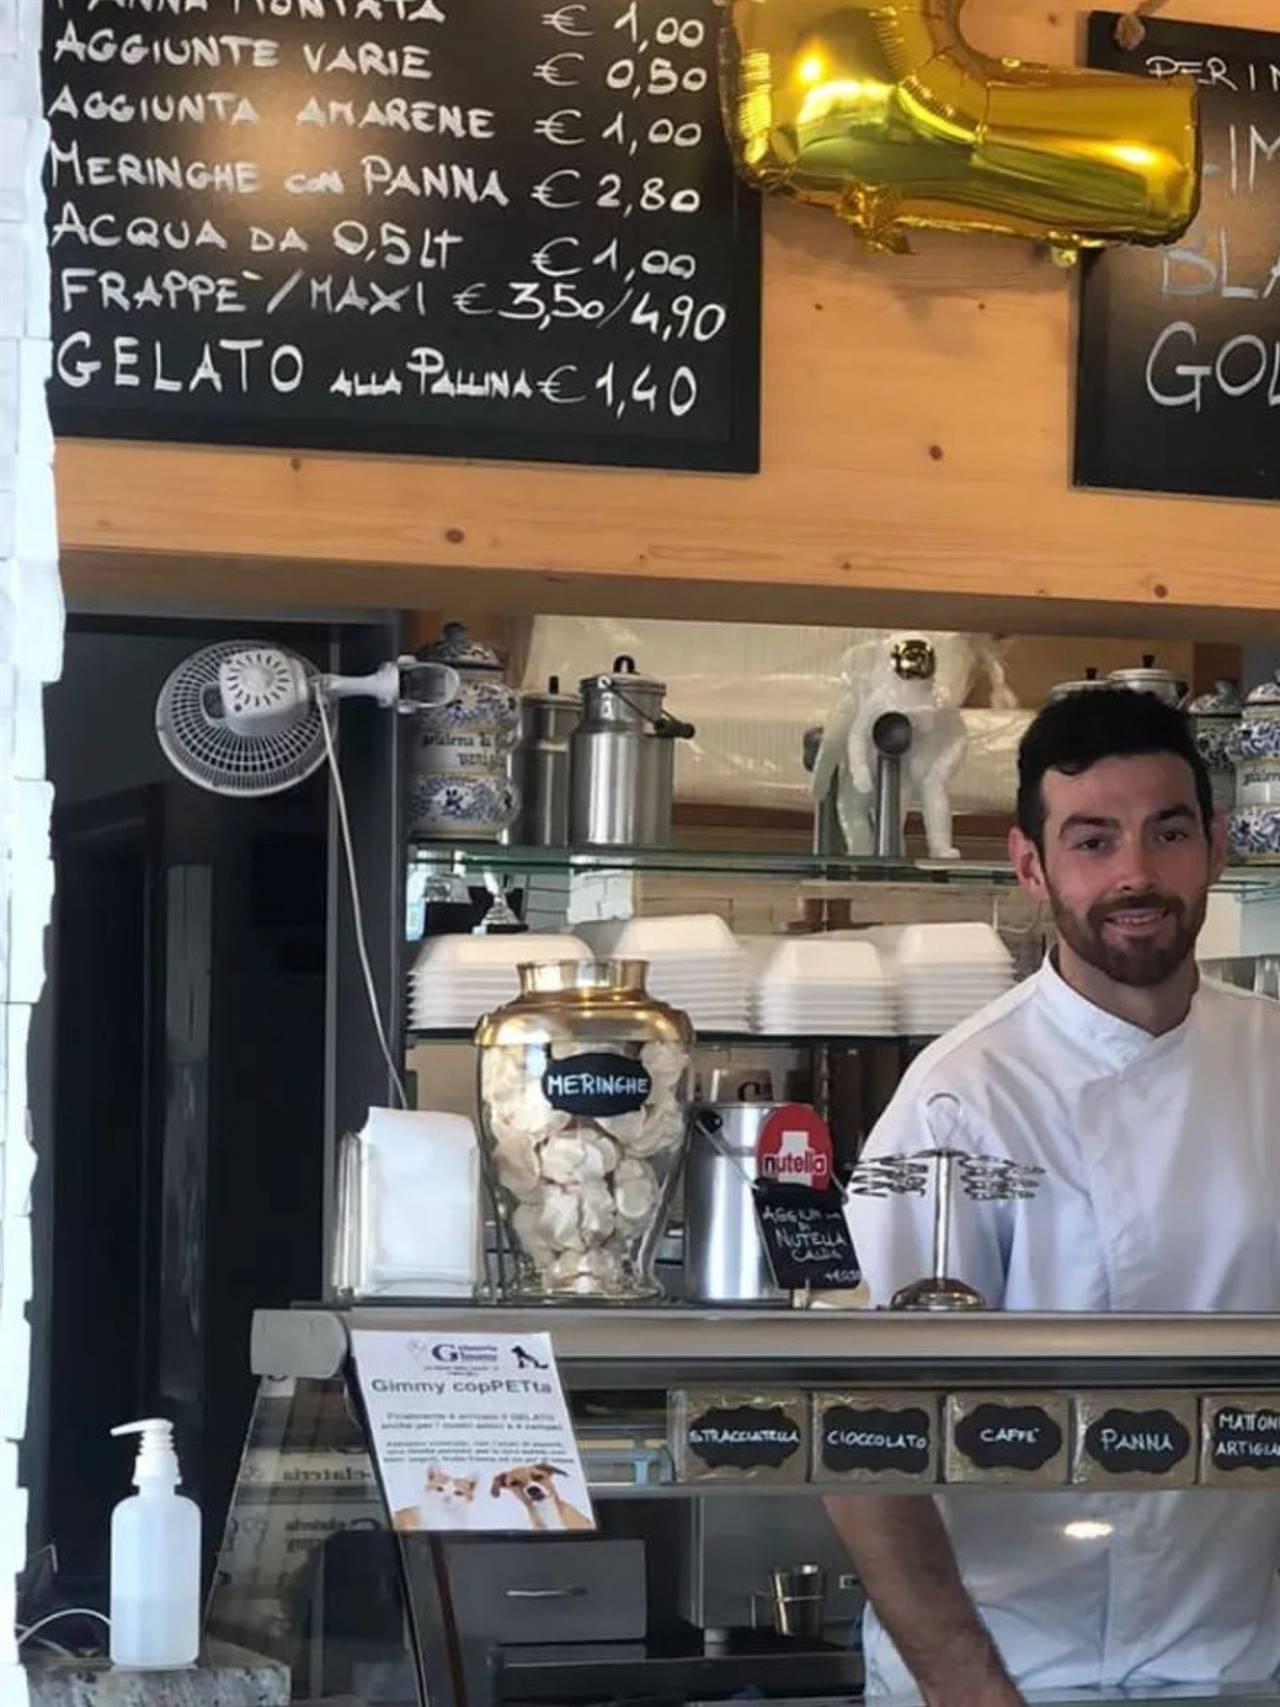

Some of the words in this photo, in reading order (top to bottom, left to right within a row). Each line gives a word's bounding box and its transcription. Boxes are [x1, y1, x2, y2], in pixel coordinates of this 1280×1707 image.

[541, 4, 595, 36] €
[613, 0, 704, 53] 1,00
[53, 19, 280, 68] AGGIUNTE
[303, 42, 433, 79] VARIE
[532, 52, 585, 86] €
[606, 57, 707, 99] 0,50
[48, 84, 259, 127] AGGIUNTA
[296, 97, 496, 139] AMARENE
[533, 108, 586, 145] €
[602, 111, 702, 155] 1,00
[49, 139, 261, 194] MERINGHE
[361, 154, 509, 208] PANNA
[531, 169, 581, 208] €
[597, 174, 700, 218] 2,80
[51, 201, 228, 249] ACQUA
[250, 224, 309, 252] DA
[532, 236, 583, 277] €
[592, 237, 696, 283] 1,00
[452, 282, 494, 316] €
[57, 330, 304, 393] GELATO
[537, 364, 587, 404] €
[595, 361, 697, 419] 1,40
[547, 1074, 648, 1097] MERINGHE
[764, 1152, 826, 1174] nutella
[775, 1228, 847, 1248] NUTELLA
[372, 1379, 445, 1394] Gimmy
[453, 1379, 551, 1394] copPETta
[827, 1431, 927, 1448] CIOCCOLATO
[1101, 1430, 1174, 1450] PANNA
